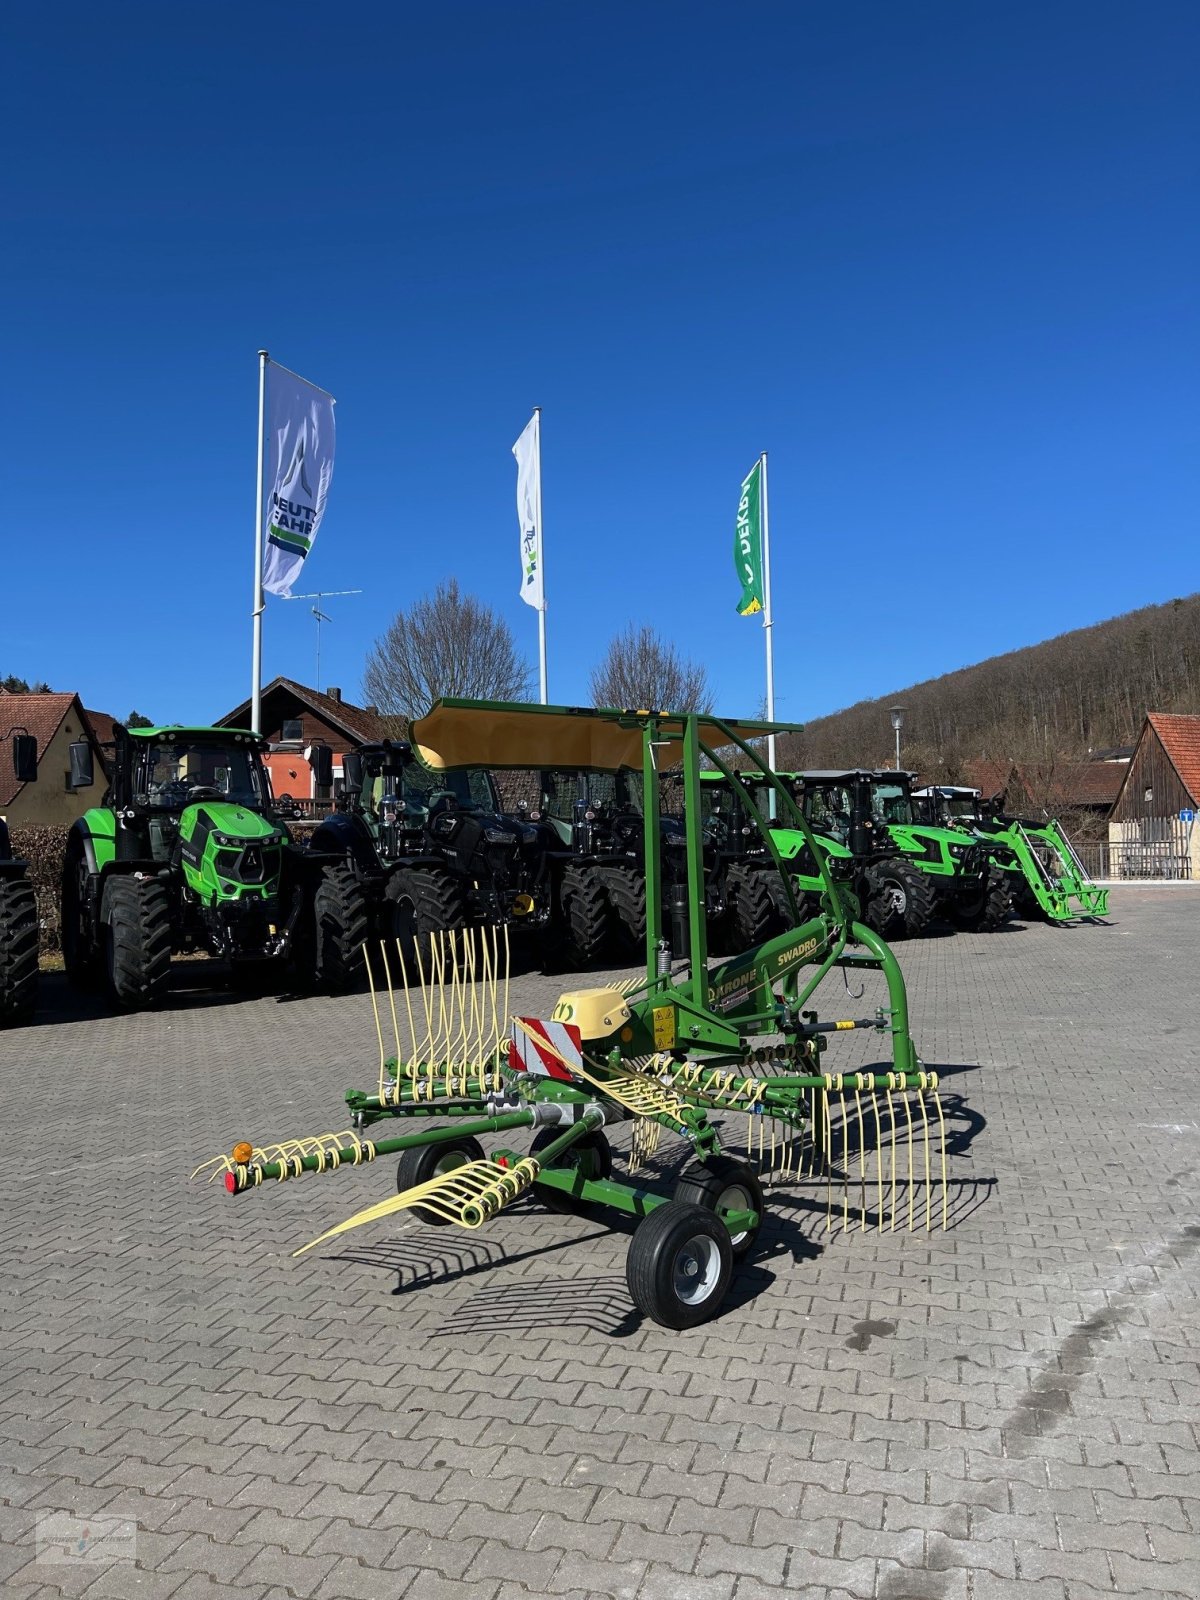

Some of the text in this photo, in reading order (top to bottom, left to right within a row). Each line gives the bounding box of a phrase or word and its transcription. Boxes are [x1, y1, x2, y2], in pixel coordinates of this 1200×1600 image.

[273, 492, 317, 523] EUT
[777, 938, 817, 966] SWADRO
[716, 968, 757, 998] KRONE
